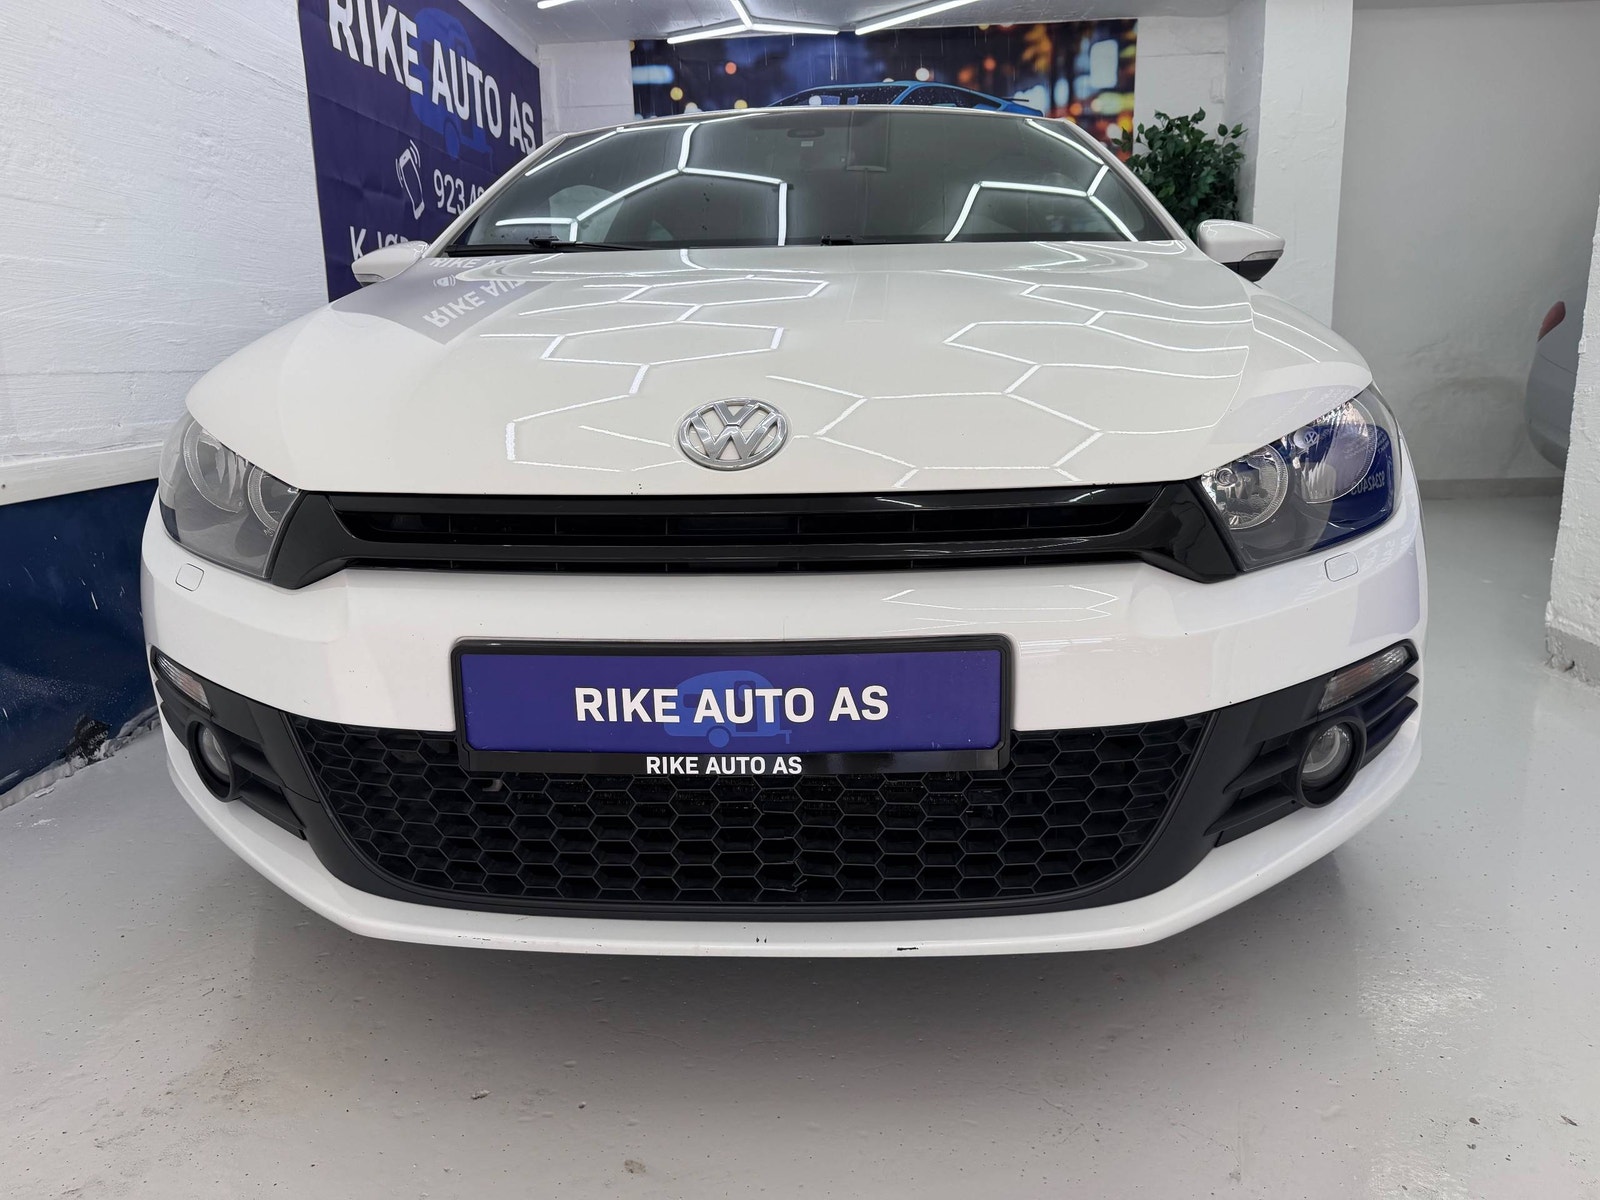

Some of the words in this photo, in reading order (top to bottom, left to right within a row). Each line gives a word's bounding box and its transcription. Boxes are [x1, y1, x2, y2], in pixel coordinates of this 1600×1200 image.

[431, 39, 502, 138] AUTO
[510, 92, 537, 154] AS
[433, 169, 466, 216] 923
[575, 687, 680, 723] RIKE
[693, 687, 814, 724] AUTO
[829, 685, 889, 721] AS
[646, 756, 699, 775] RIKE
[705, 756, 766, 775] AUTO
[772, 756, 802, 775] AS
